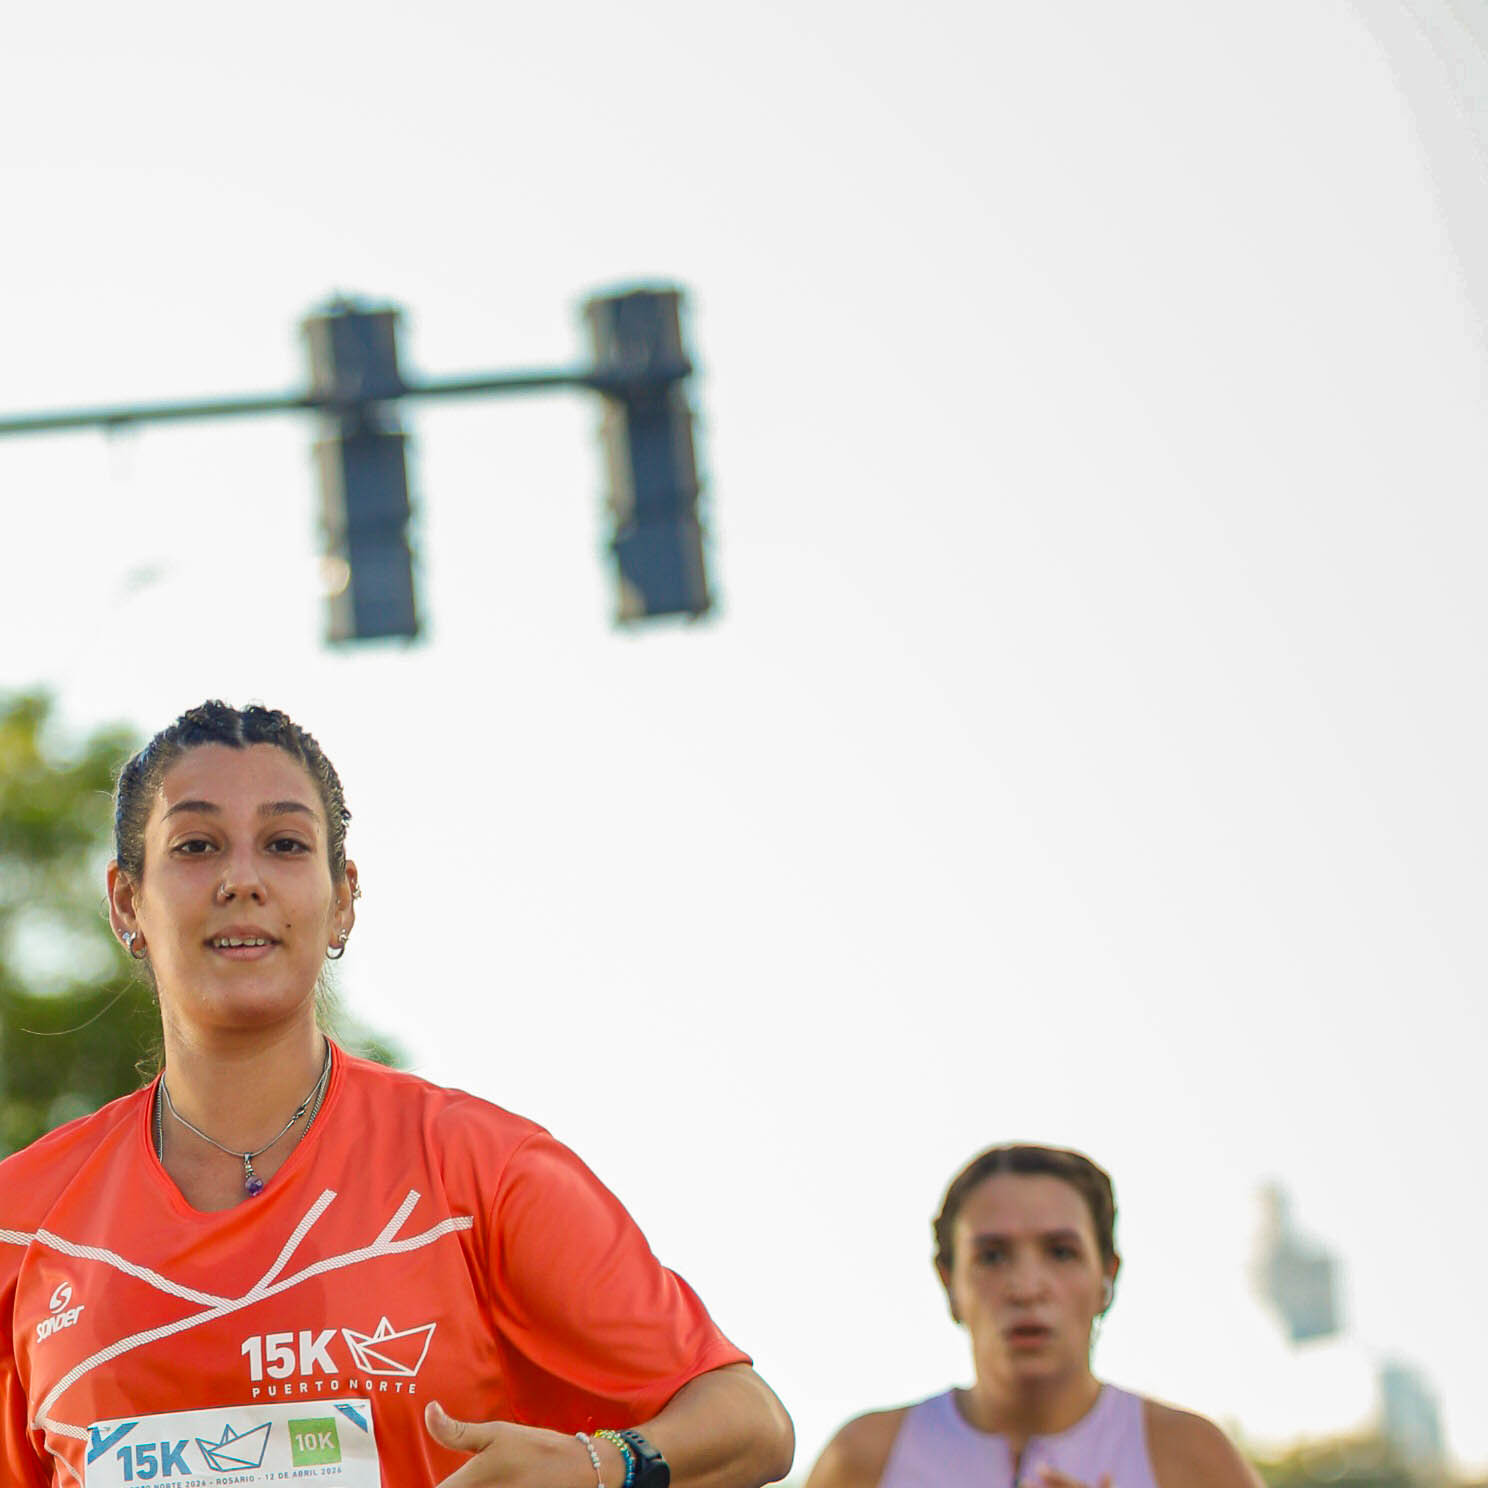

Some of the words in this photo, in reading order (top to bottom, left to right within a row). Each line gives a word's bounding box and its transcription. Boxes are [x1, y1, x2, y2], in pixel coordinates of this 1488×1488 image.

[241, 1329, 339, 1382] 15K
[252, 1379, 340, 1398] PUERTO
[349, 1379, 417, 1395] NORTE
[295, 1431, 336, 1452] 10K
[116, 1439, 193, 1482] 15K
[216, 1475, 255, 1485] ROSARIO
[265, 1473, 274, 1481] 12
[278, 1471, 288, 1479] DE
[292, 1469, 317, 1477] ABRIL
